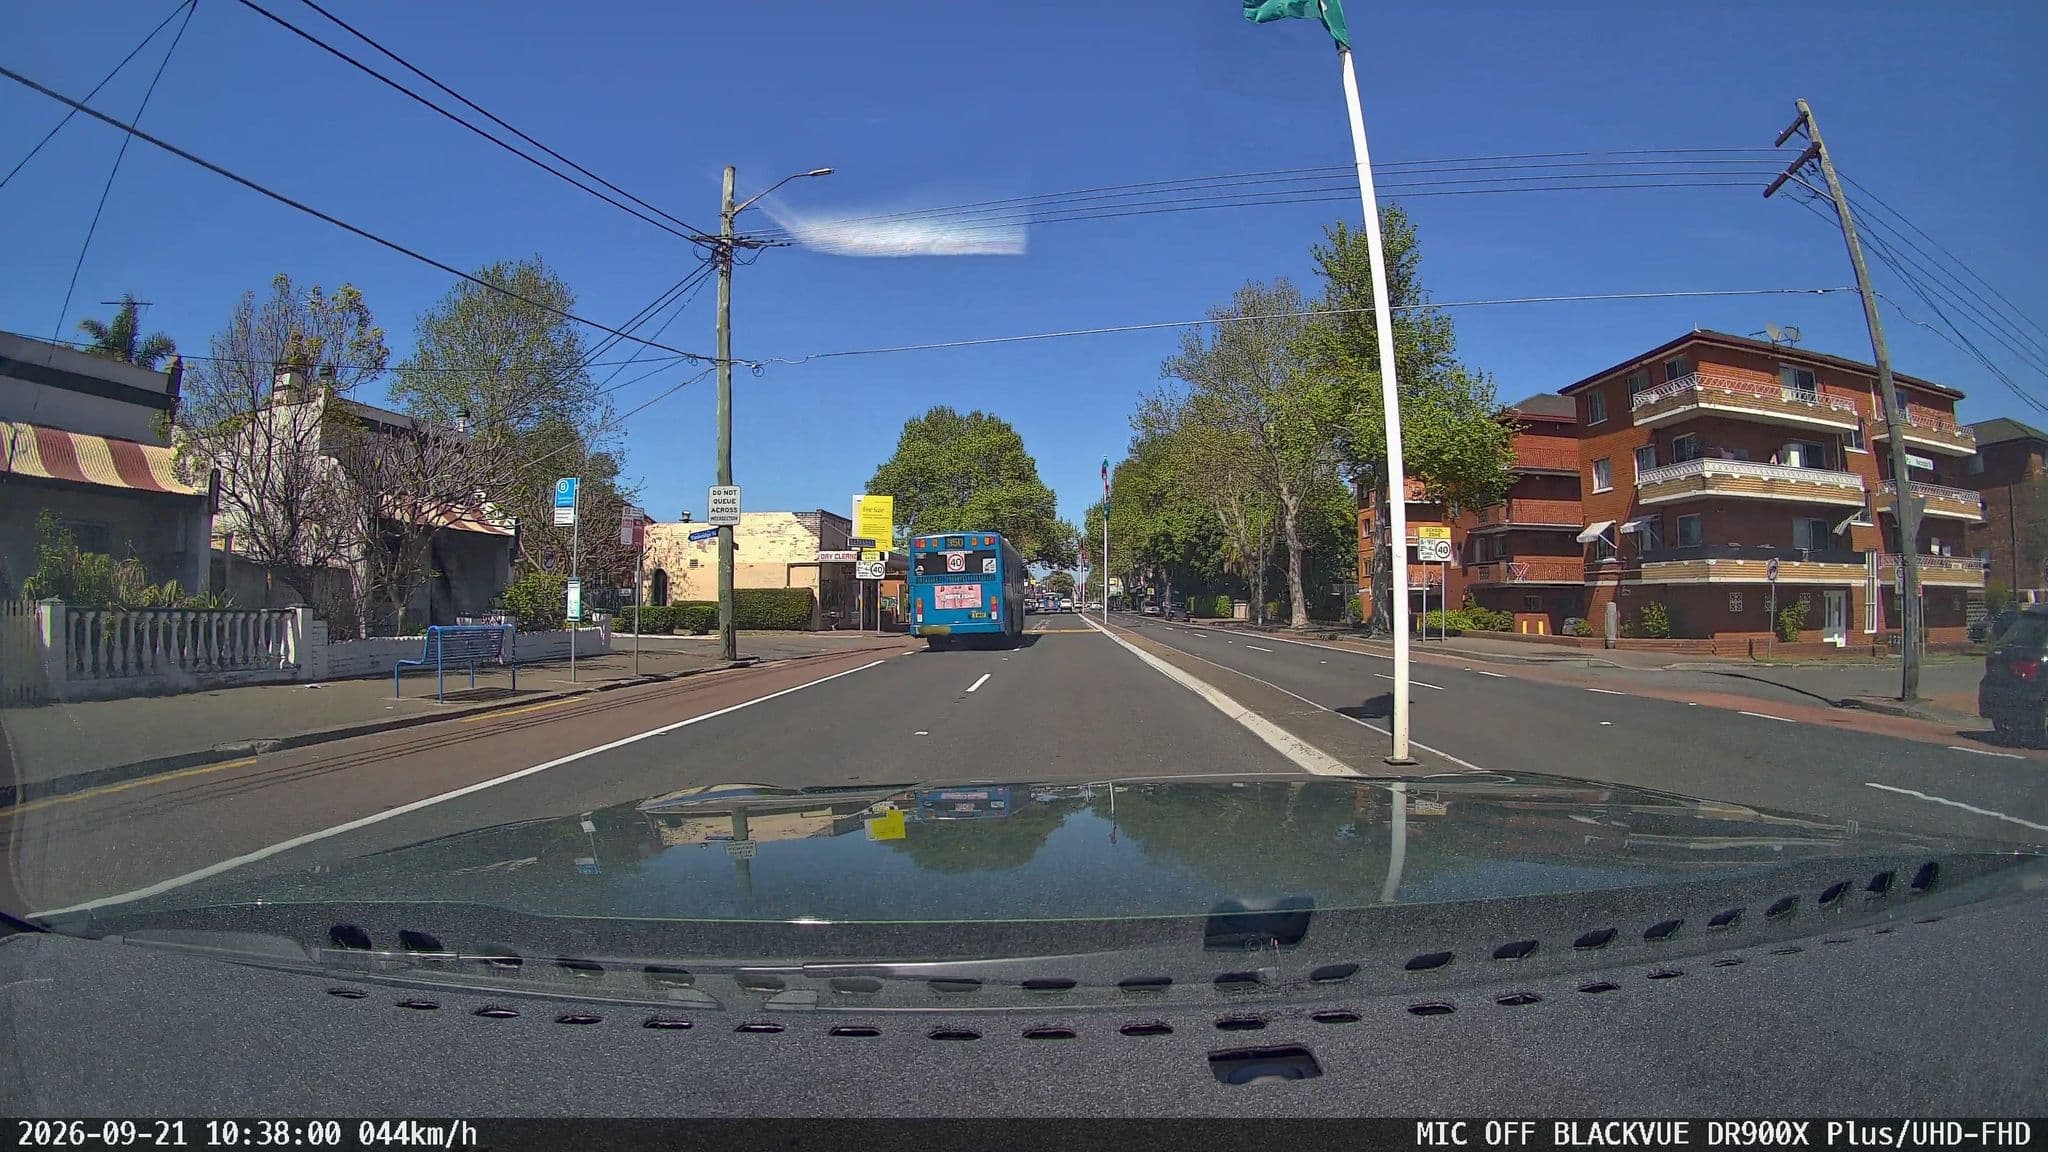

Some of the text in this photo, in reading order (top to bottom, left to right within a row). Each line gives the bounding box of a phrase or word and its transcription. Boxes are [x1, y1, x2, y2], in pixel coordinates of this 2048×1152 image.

[1438, 546, 1449, 554] 40
[951, 558, 961, 567] 40
[872, 566, 883, 574] 40
